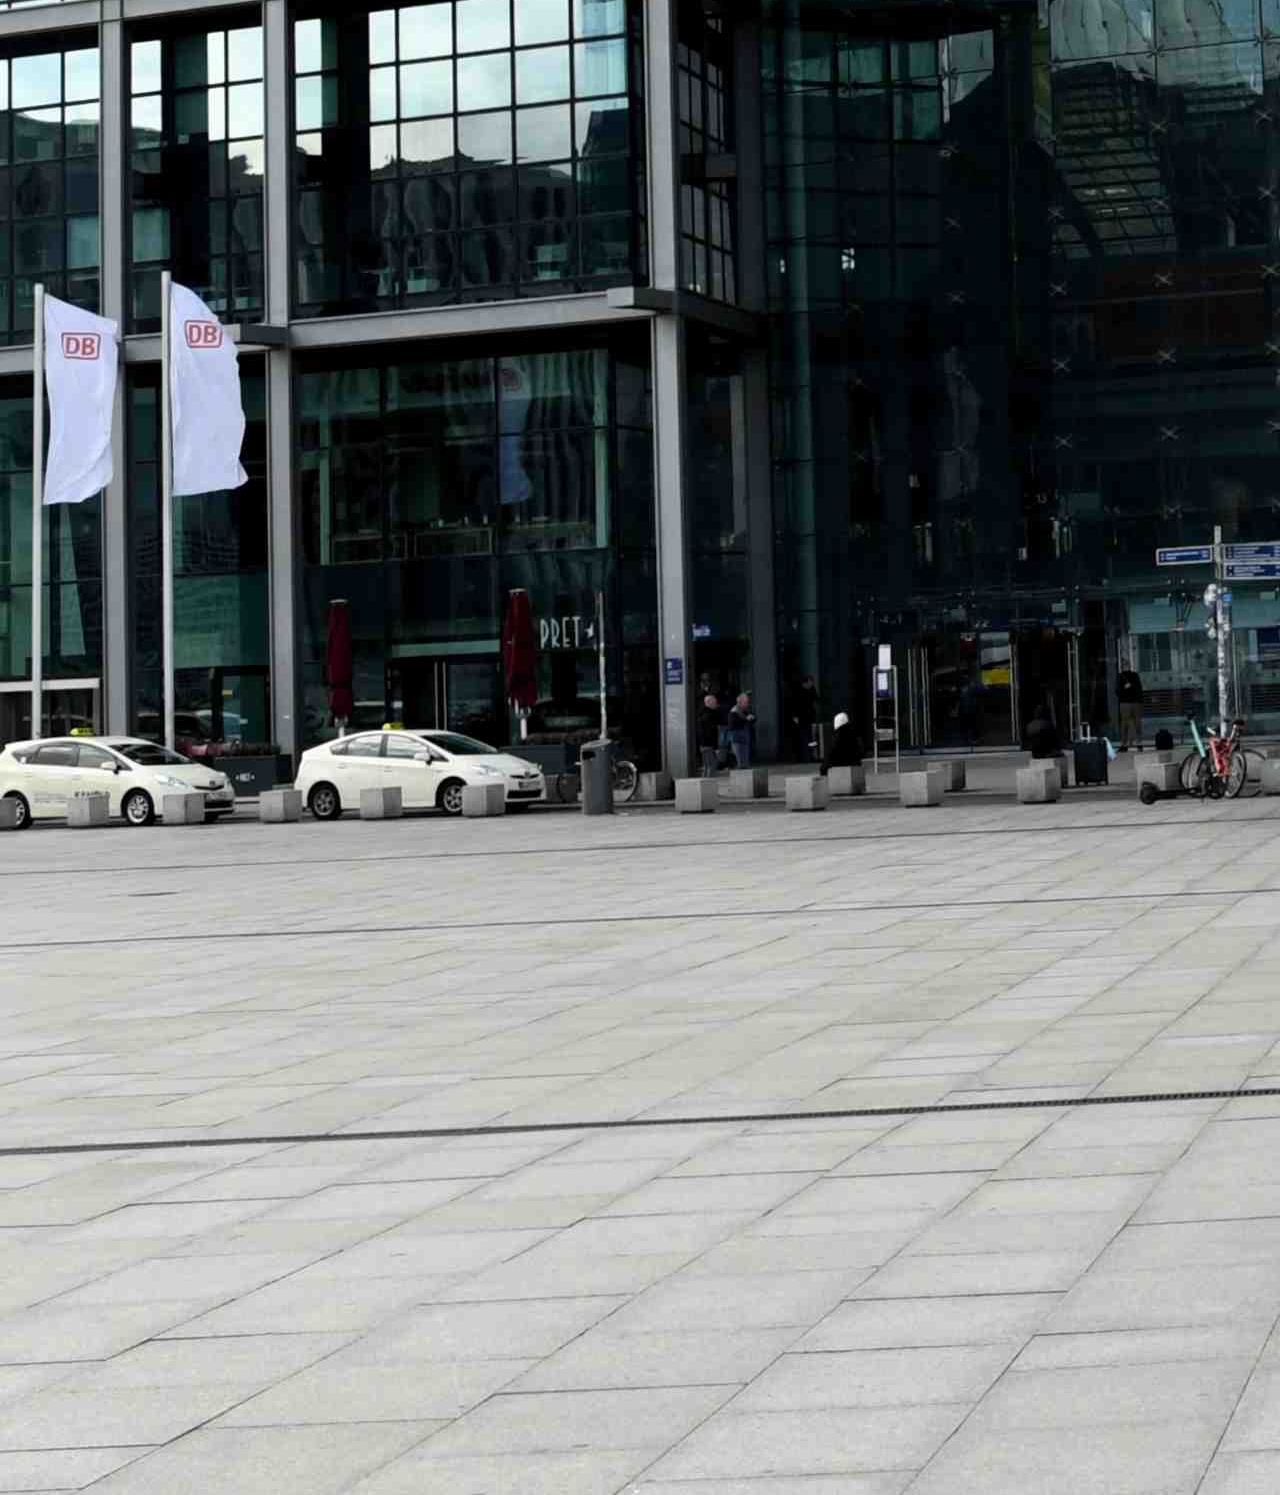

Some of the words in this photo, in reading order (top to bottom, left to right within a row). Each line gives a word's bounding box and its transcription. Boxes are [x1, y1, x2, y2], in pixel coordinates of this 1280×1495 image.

[187, 324, 219, 345] DB
[64, 335, 97, 357] DB
[539, 615, 581, 649] PRET
